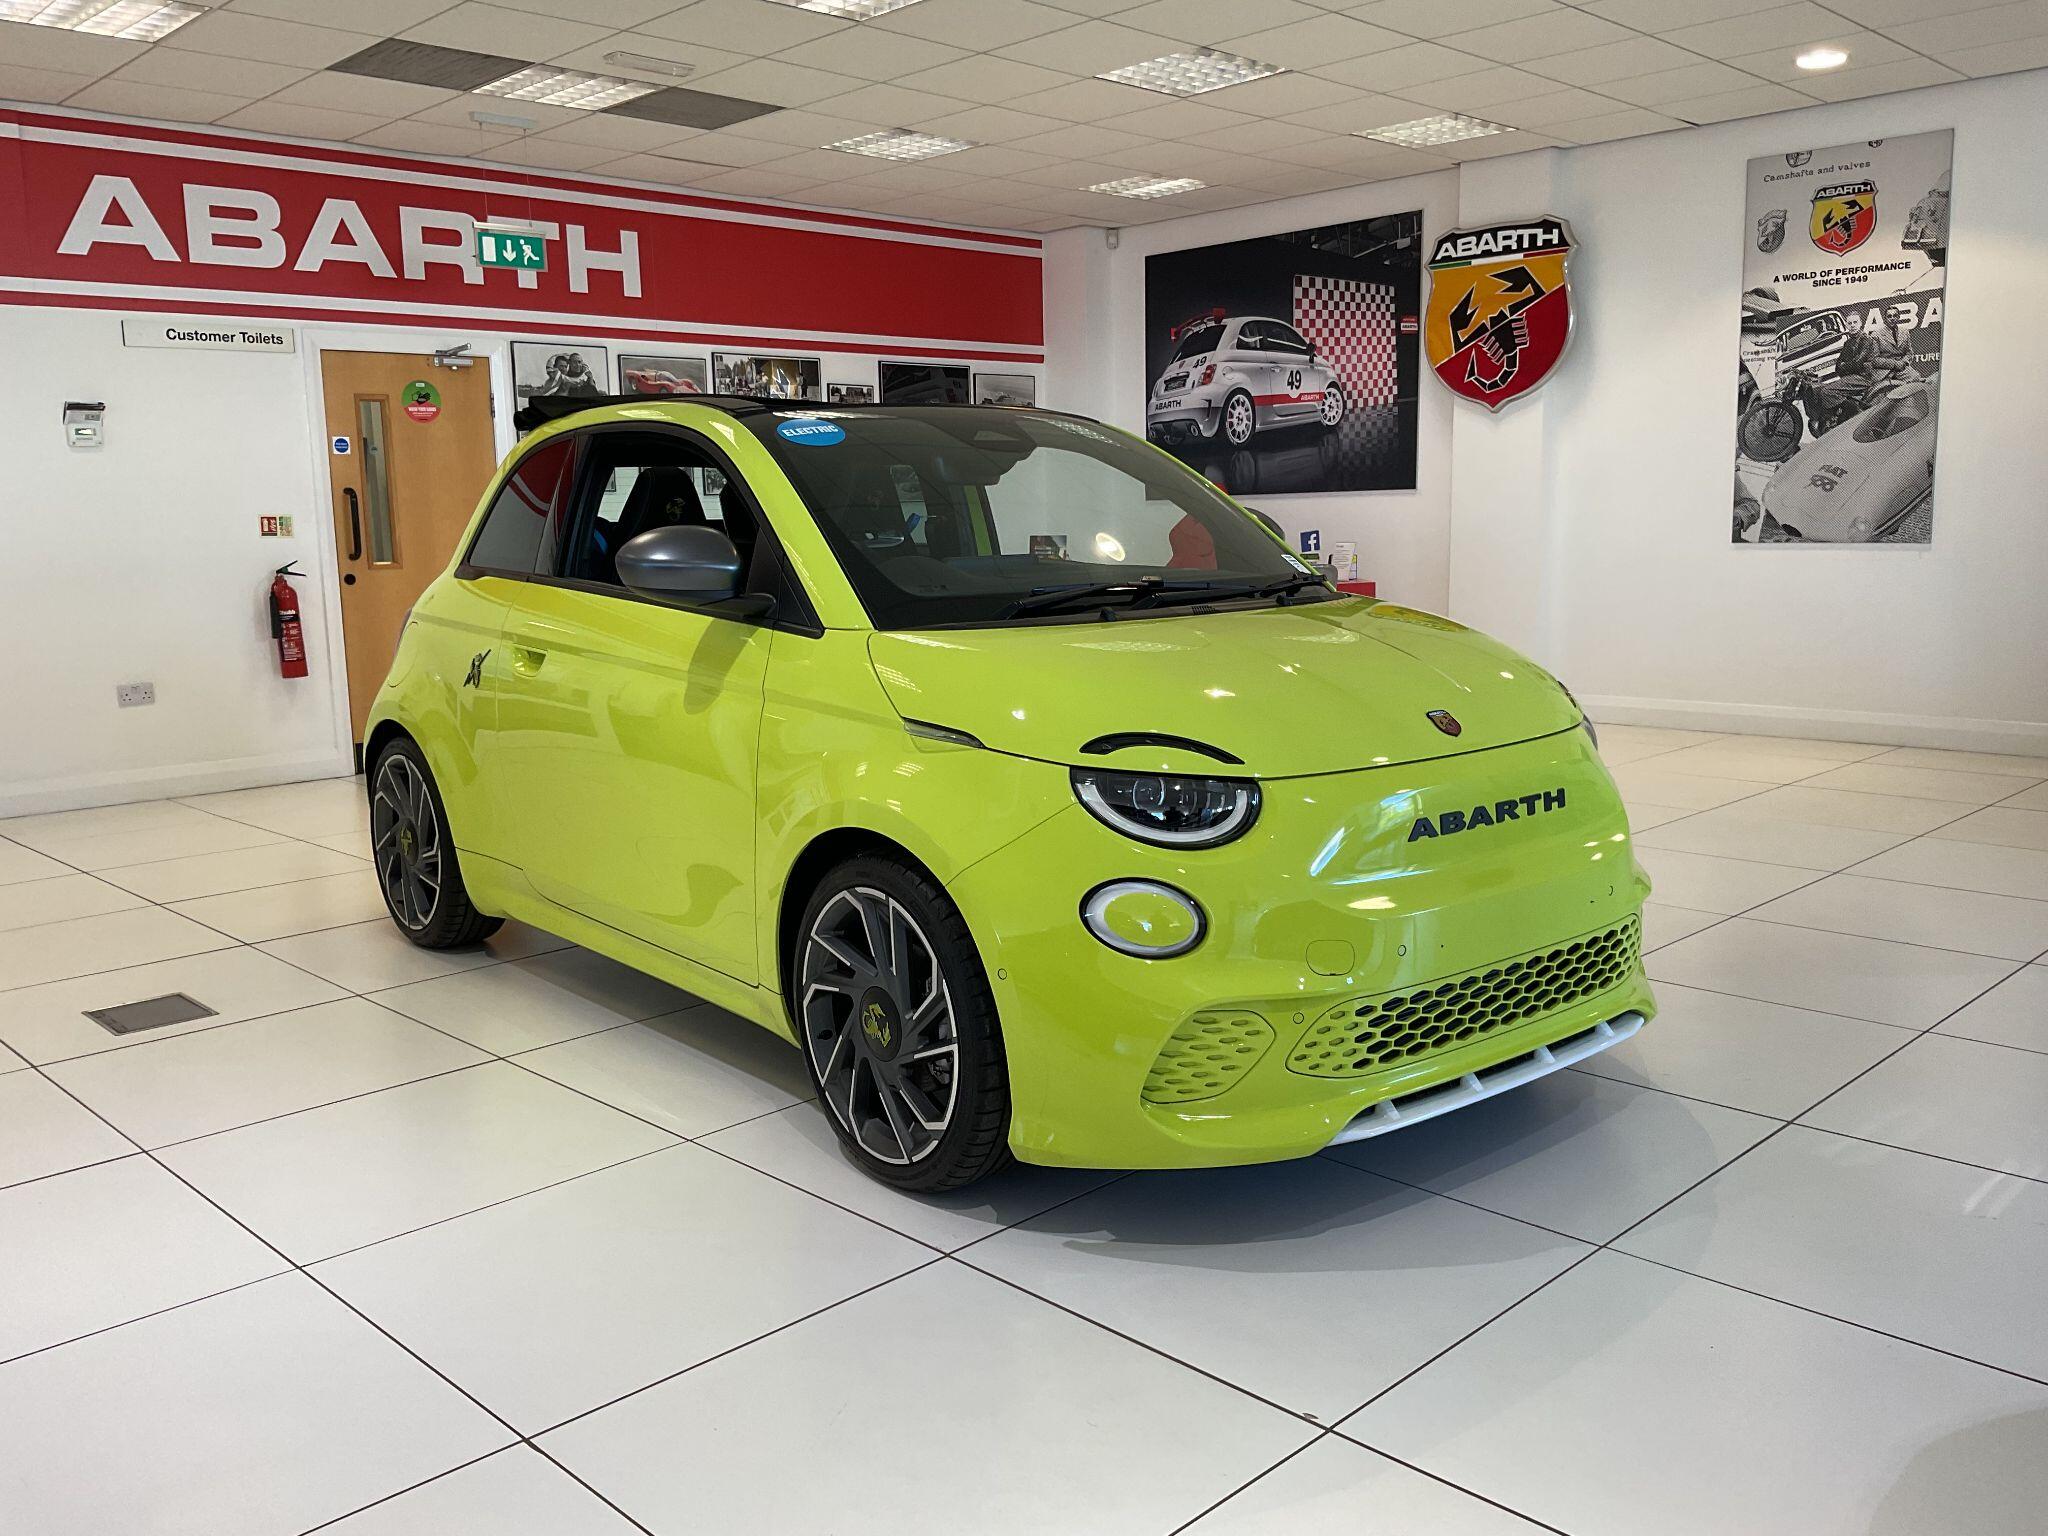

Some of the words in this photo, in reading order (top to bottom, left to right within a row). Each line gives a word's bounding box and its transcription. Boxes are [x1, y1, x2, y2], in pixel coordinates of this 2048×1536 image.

[1817, 165, 1835, 176] and
[1838, 160, 1871, 172] valves
[1816, 184, 1871, 199] ABARTH
[1435, 228, 1559, 261] ABARTH
[1773, 275, 1780, 283] A
[1782, 270, 1817, 282] WORLD
[1819, 269, 1833, 278] OF
[1835, 261, 1912, 277] PERFORMANCE
[1812, 277, 1842, 288] SINCE
[1845, 274, 1869, 285] 1949
[165, 328, 237, 343] Customer
[239, 331, 284, 345] Toilets
[1192, 356, 1208, 369] 49
[1286, 370, 1302, 391] 49
[1301, 393, 1321, 401] ABARTH
[1154, 399, 1182, 412] ABARTH
[781, 425, 839, 437] ELECTRIC
[1407, 787, 1567, 842] ABARTH
